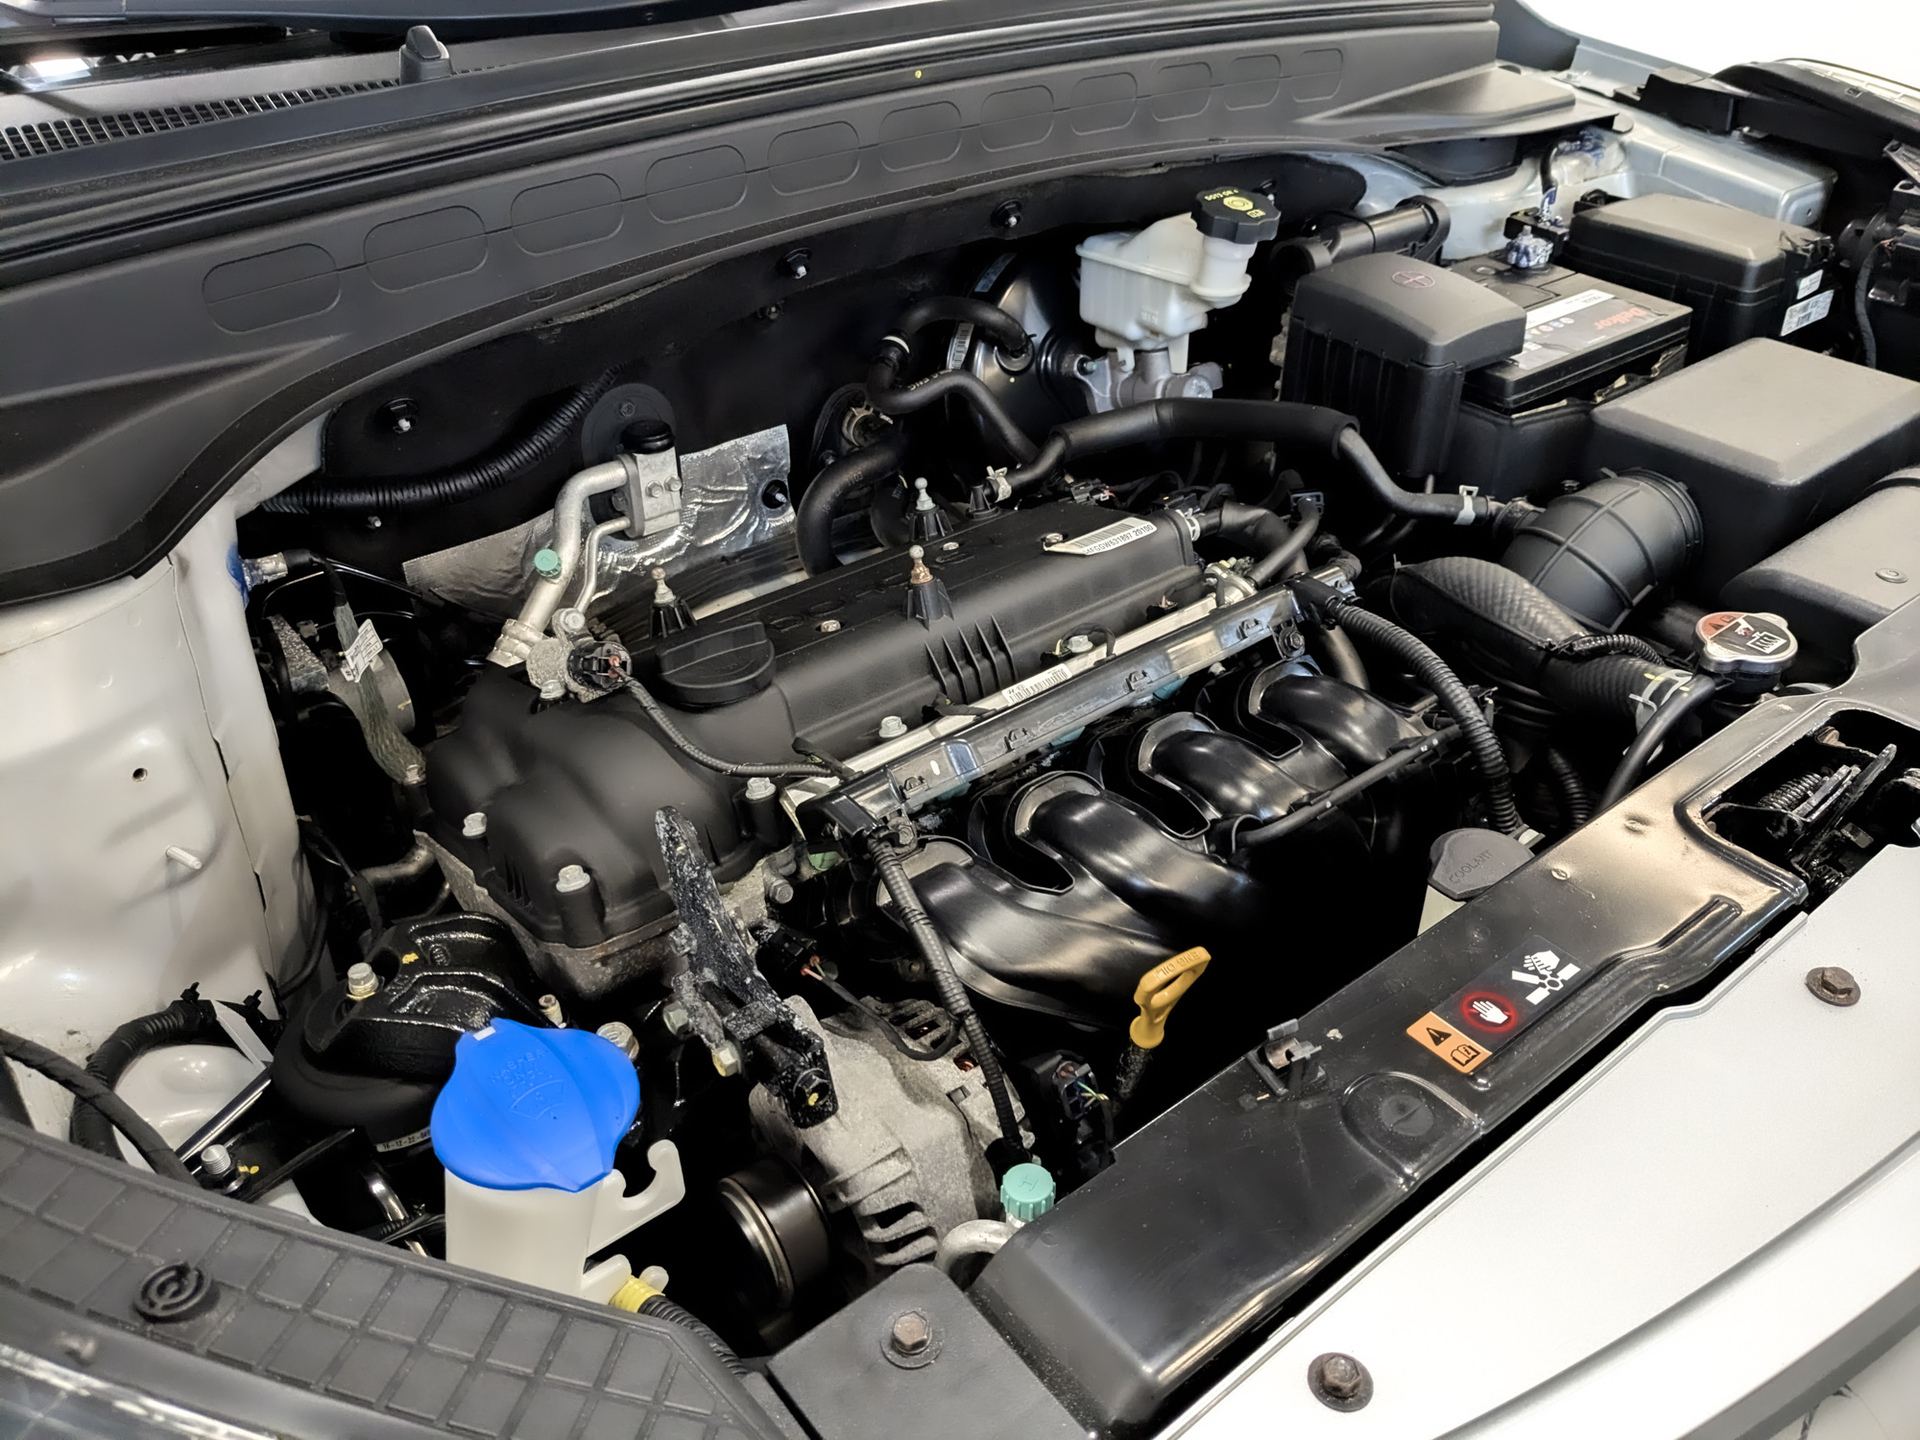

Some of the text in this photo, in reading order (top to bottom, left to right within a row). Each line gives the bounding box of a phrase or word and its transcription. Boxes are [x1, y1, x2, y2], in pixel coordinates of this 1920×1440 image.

[1593, 306, 1648, 331] Delkor
[1134, 524, 1154, 537] 20100
[1449, 849, 1494, 884] COOLANT
